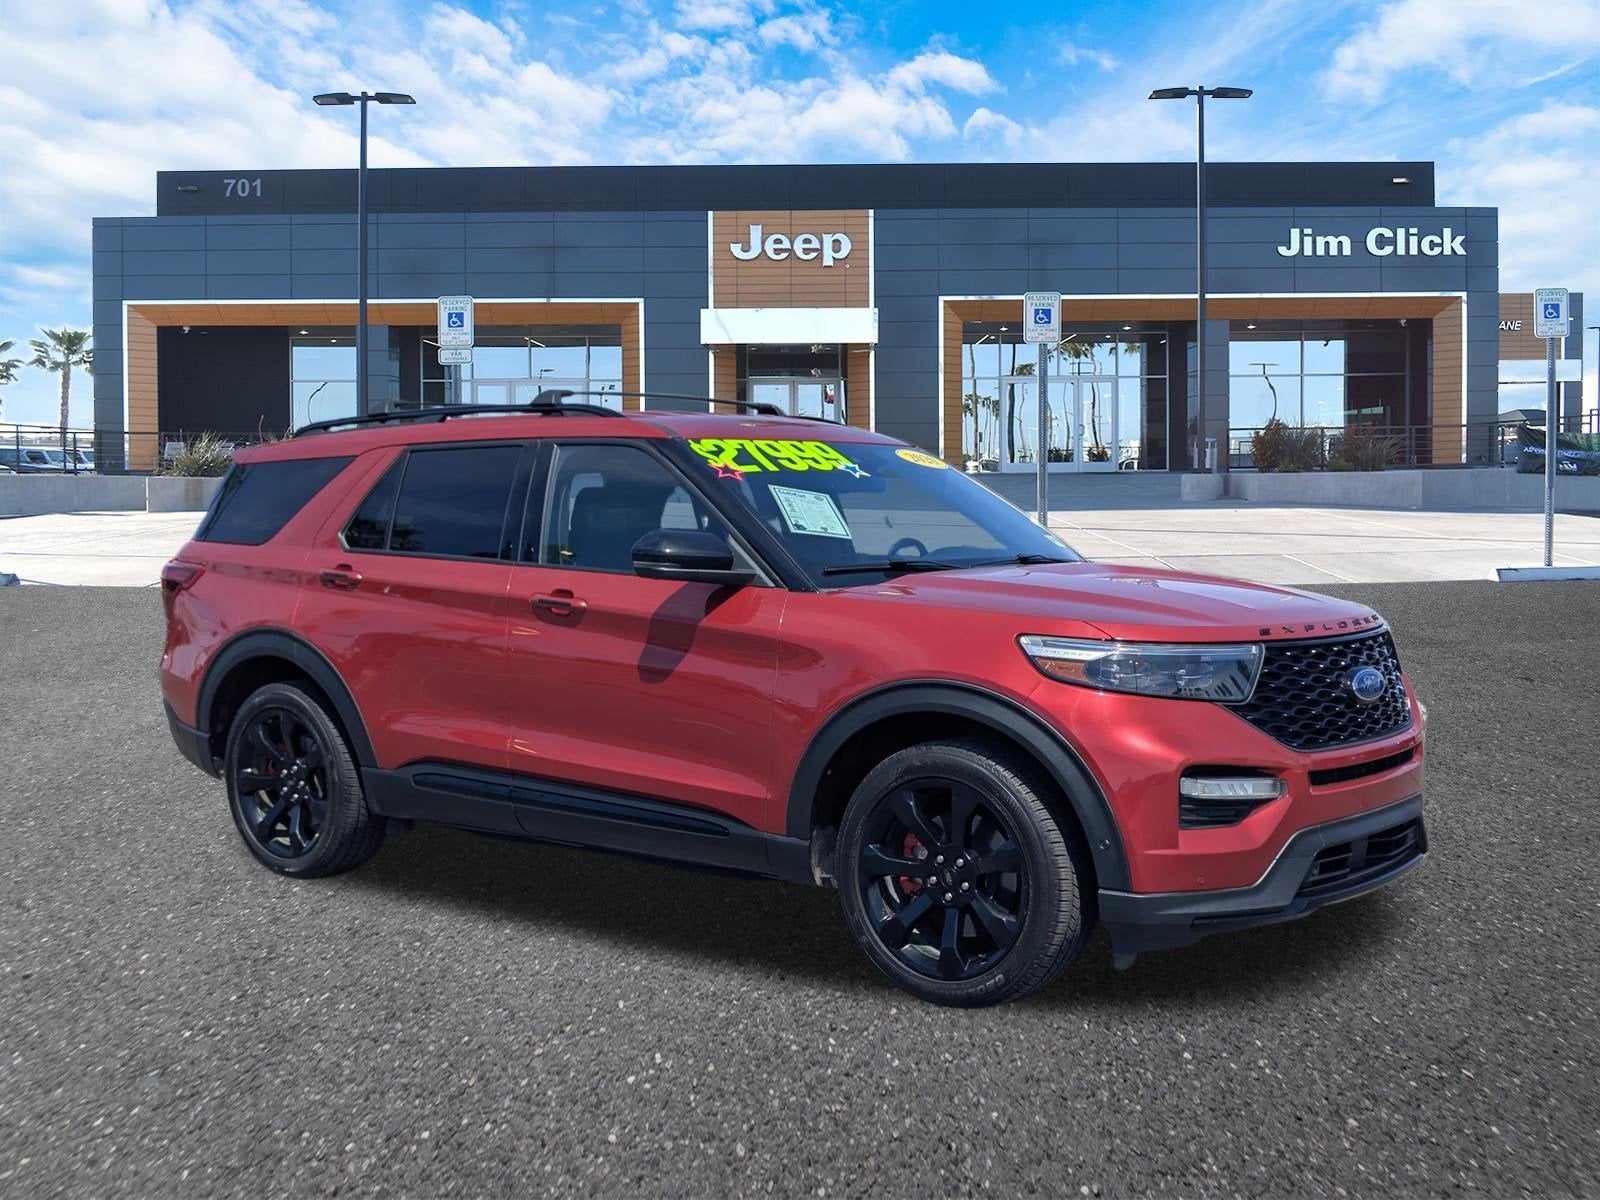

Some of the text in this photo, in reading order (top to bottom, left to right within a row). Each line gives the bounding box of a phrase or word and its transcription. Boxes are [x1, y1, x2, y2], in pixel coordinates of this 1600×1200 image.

[223, 178, 262, 197] 701
[730, 224, 852, 267] Jeep
[1277, 227, 1467, 257] Jim Click
[1499, 320, 1522, 331] ANE
[688, 439, 853, 472] $27999
[1259, 614, 1379, 636] EXPLORER
